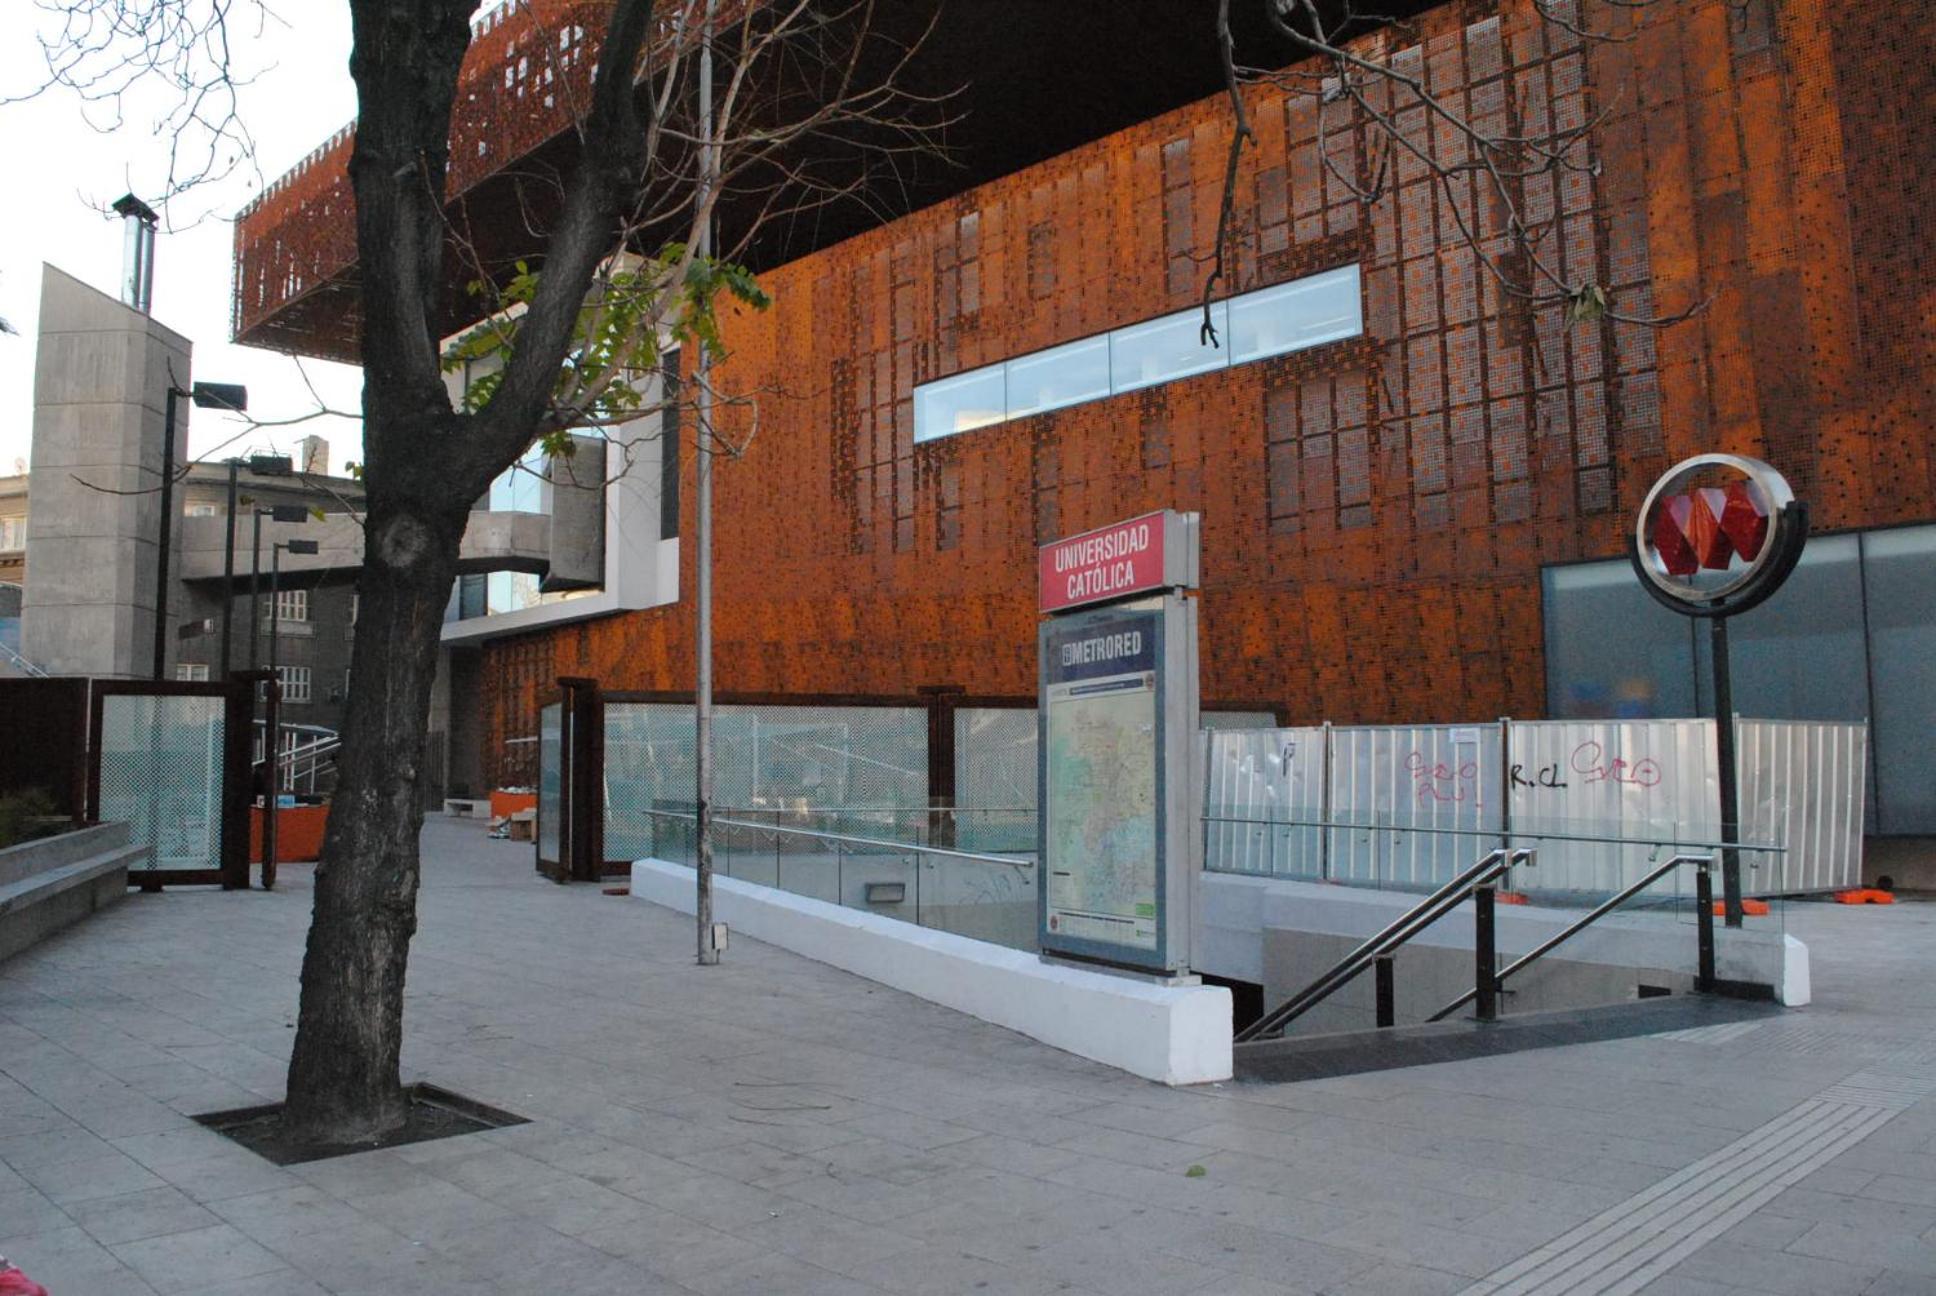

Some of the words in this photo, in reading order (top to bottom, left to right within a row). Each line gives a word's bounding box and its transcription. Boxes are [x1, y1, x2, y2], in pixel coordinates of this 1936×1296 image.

[1055, 524, 1149, 573] UNIVERSIDAD
[1067, 560, 1135, 600] CATÓLICA
[1072, 631, 1142, 665] METRORED
